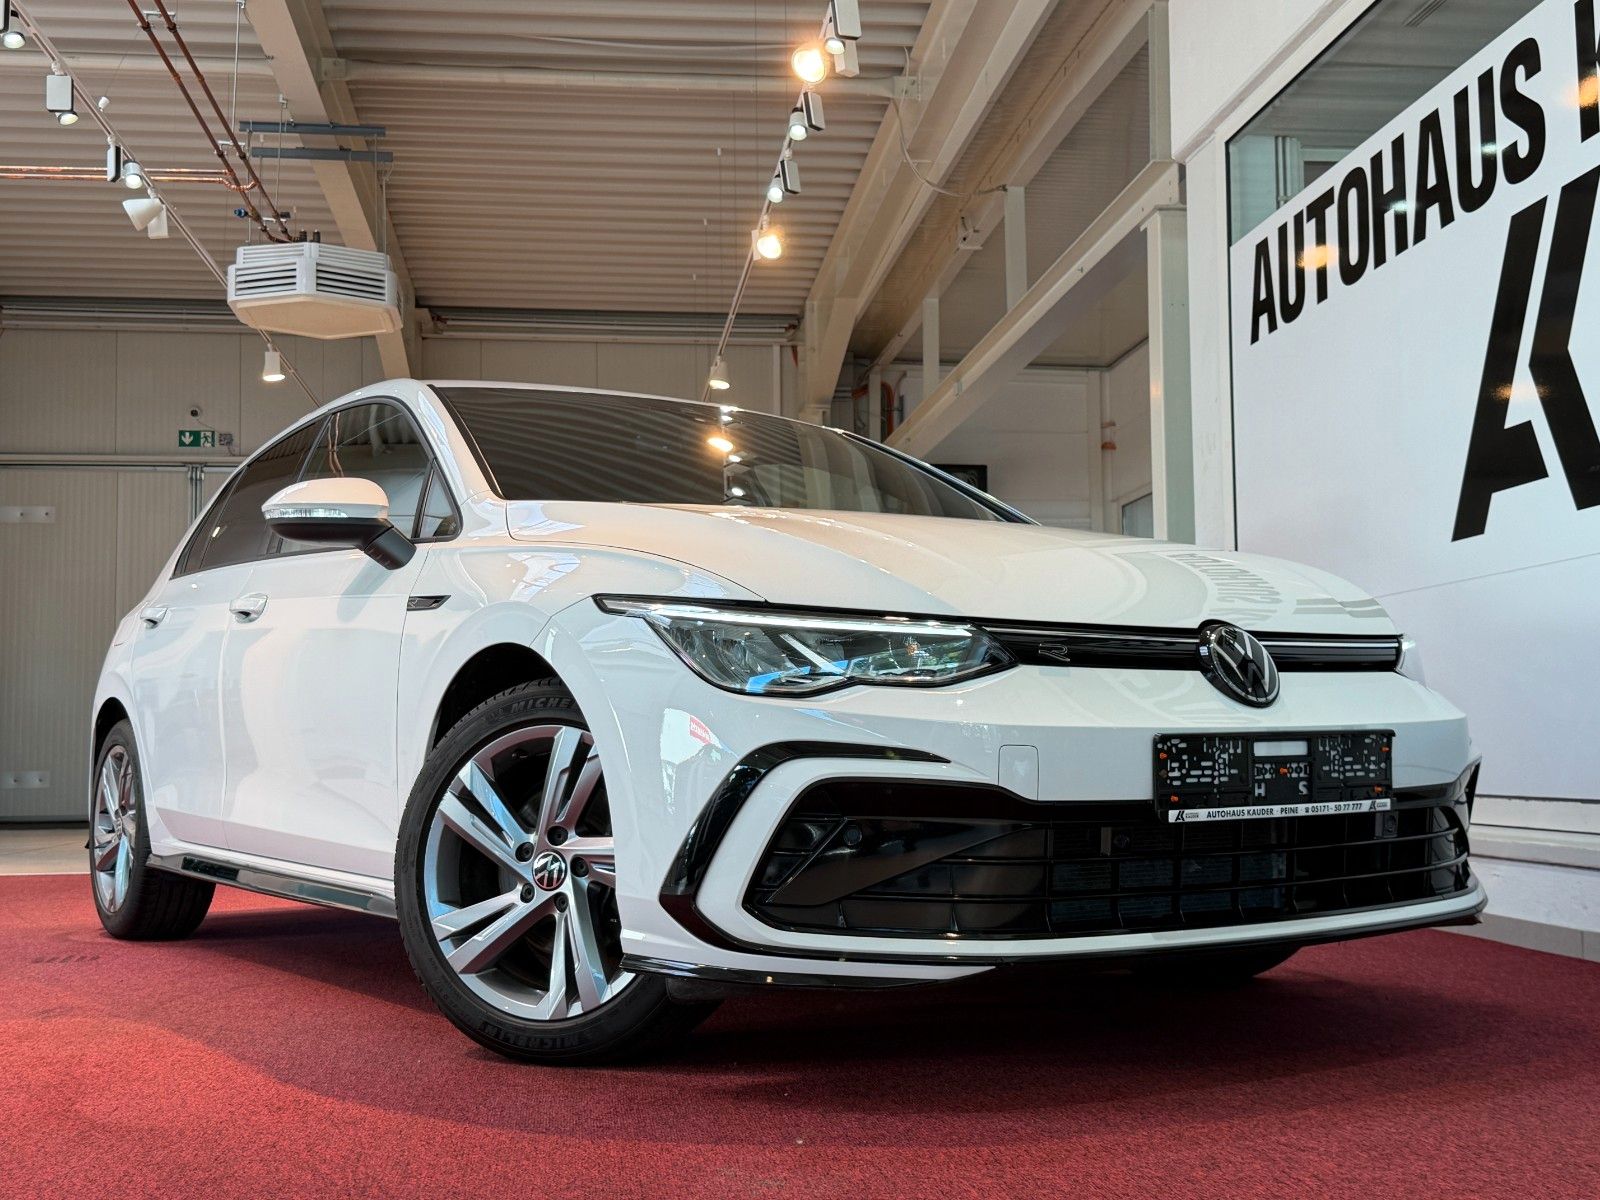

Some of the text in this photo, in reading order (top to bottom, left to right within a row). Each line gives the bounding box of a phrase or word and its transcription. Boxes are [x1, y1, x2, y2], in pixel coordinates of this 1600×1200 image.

[1250, 37, 1546, 346] AUTOHAUS
[1206, 809, 1245, 819] AUTOHAUS
[1247, 808, 1274, 817] KAUDER
[1280, 806, 1298, 815] PEINE
[1334, 804, 1342, 812] 50
[1343, 803, 1351, 811] 77
[1352, 802, 1363, 811] 777
